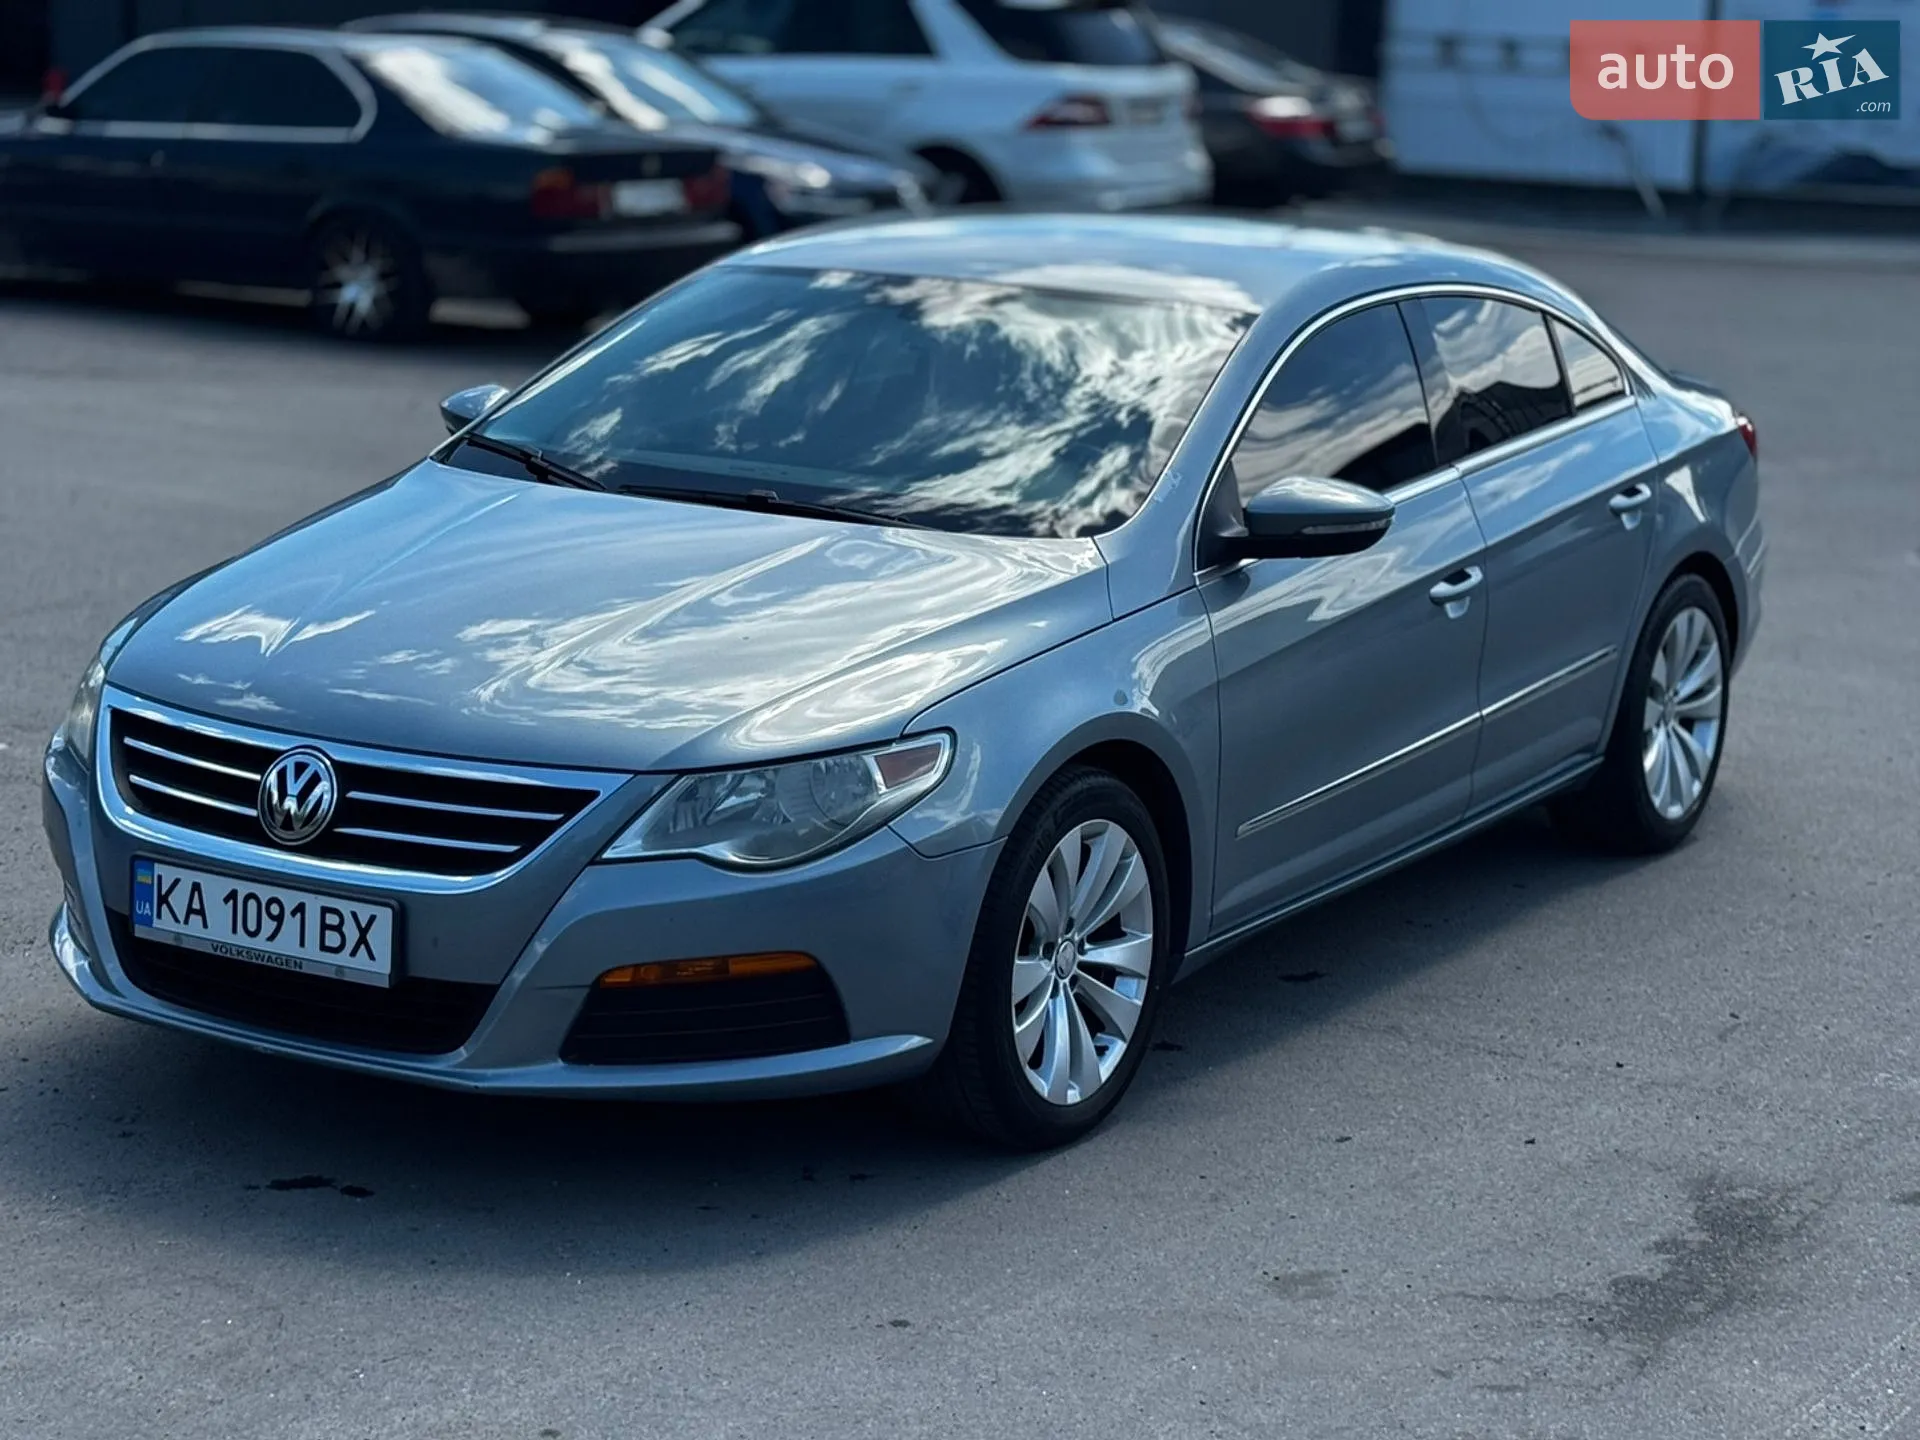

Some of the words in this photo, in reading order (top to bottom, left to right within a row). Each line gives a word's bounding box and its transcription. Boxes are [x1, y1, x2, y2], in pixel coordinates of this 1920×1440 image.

[135, 901, 151, 917] UA
[156, 873, 209, 930] KA
[222, 888, 307, 949] 1091
[318, 905, 378, 962] BX
[210, 943, 303, 970] VOLKSWAGEN
